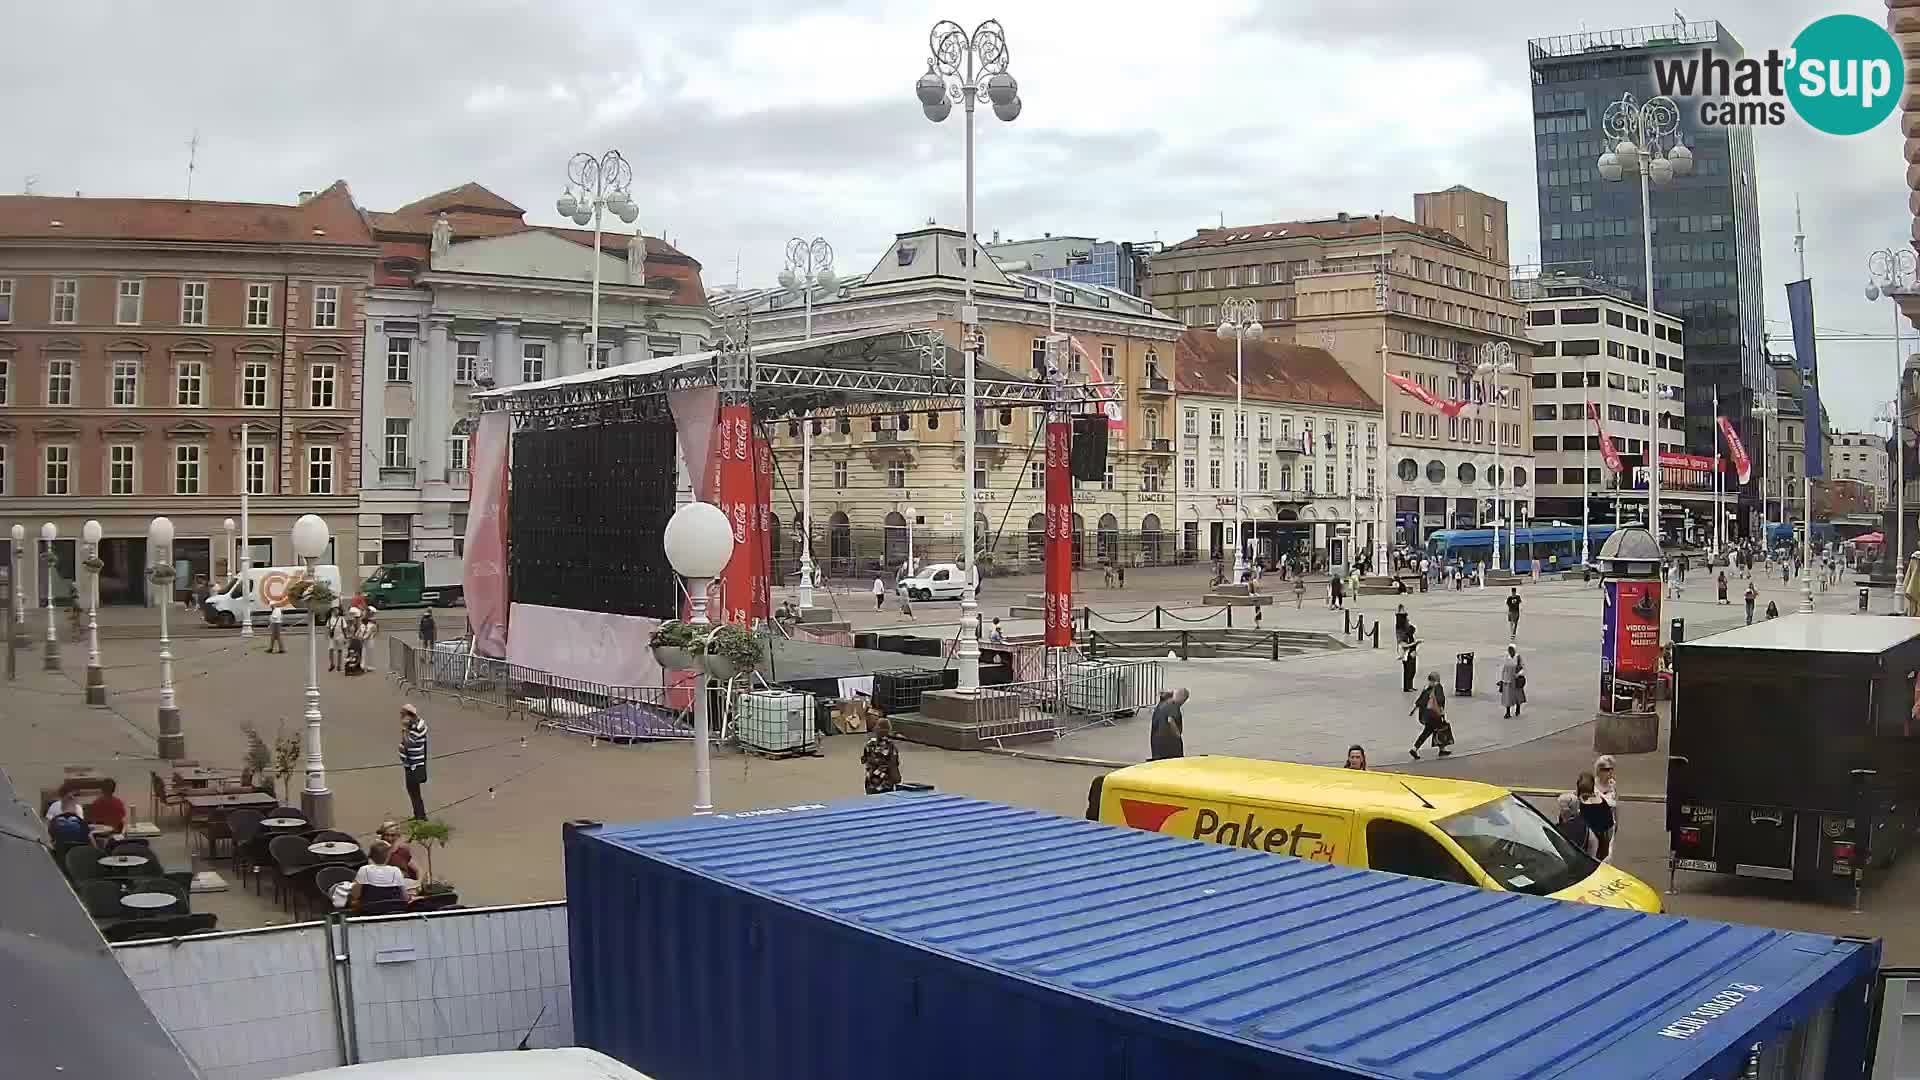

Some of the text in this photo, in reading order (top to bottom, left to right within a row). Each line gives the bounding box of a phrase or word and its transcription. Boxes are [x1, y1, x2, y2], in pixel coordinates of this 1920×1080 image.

[735, 417, 747, 460] Coca-Cola
[961, 490, 995, 500] SGER
[735, 501, 746, 544] Coca-Cola
[1060, 592, 1069, 628] Coca-Cola
[1193, 808, 1322, 857] Paket
